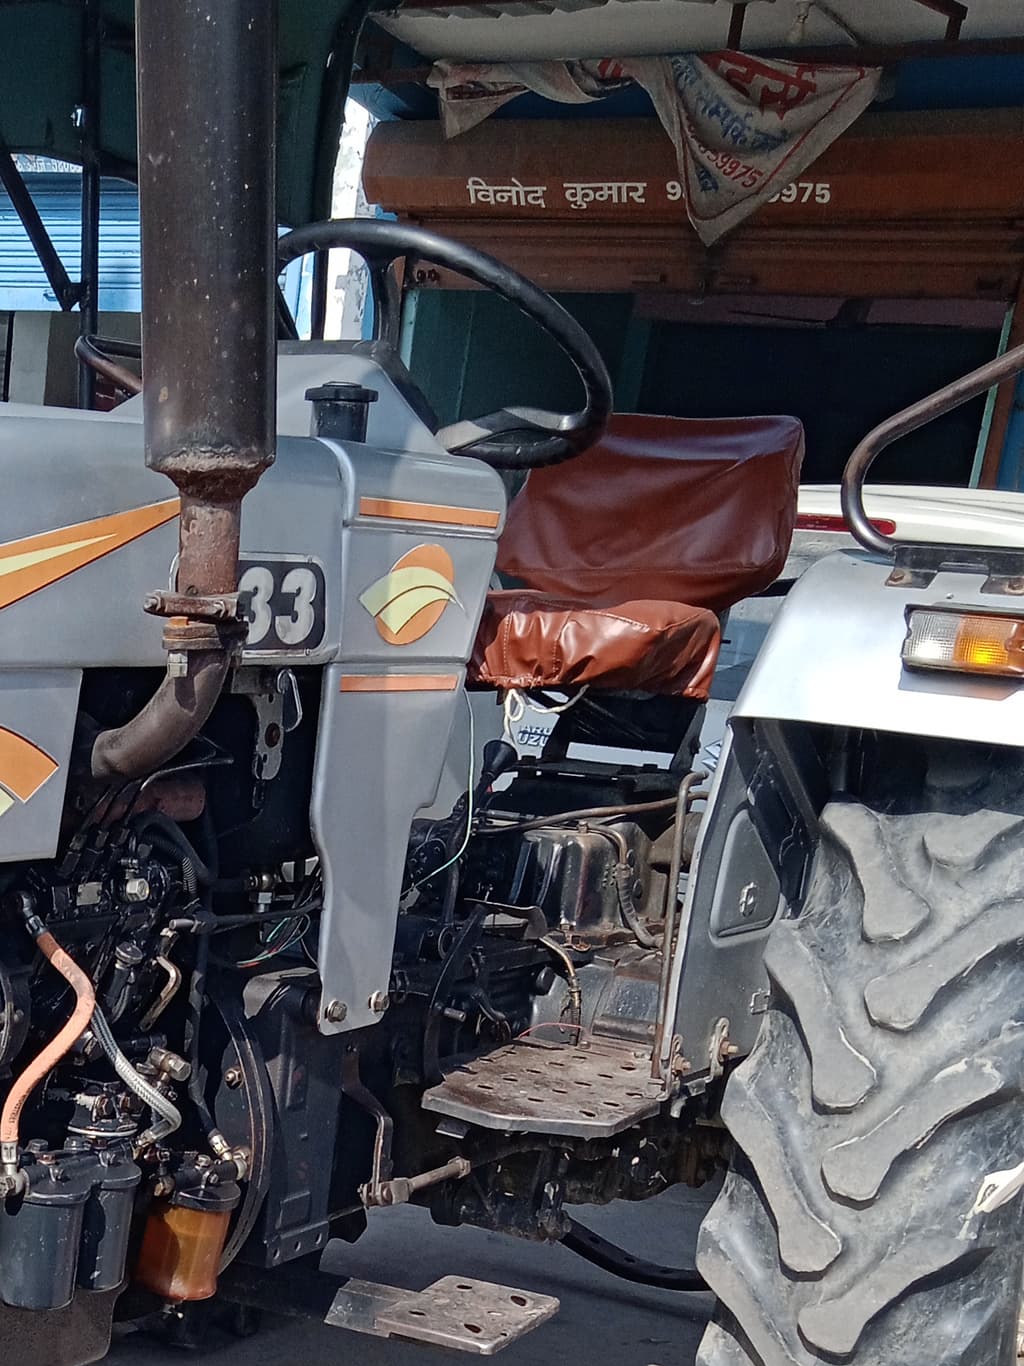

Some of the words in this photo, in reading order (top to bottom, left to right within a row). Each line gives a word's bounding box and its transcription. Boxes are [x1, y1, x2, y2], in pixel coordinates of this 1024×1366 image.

[466, 176, 547, 208] विनोद
[563, 181, 648, 209] कुमार
[238, 565, 317, 645] 33
[519, 732, 549, 747] UZU
[521, 724, 552, 735] ARU
